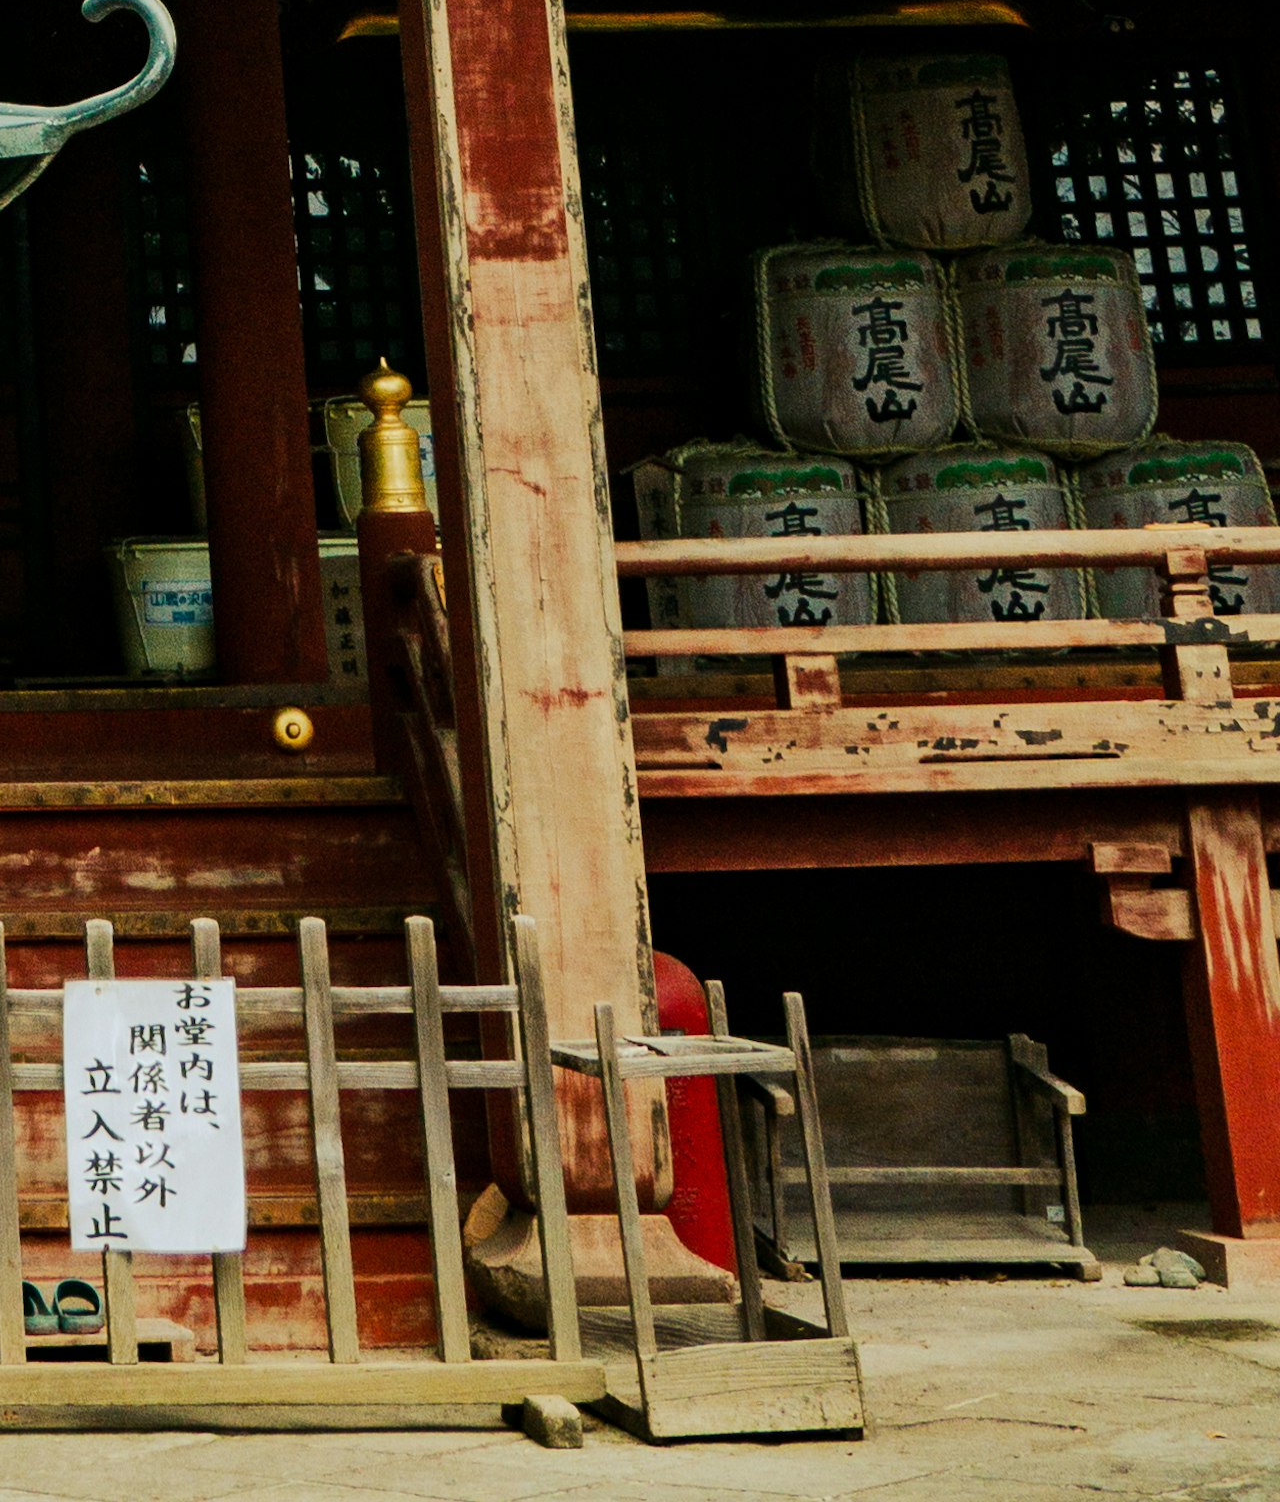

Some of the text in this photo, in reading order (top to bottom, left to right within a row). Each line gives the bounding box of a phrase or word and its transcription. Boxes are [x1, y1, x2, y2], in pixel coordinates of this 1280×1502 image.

[128, 1024, 178, 1208] 関係者以外
[173, 982, 220, 1130] お堂内は、
[80, 1057, 128, 1240] 立入禁止
